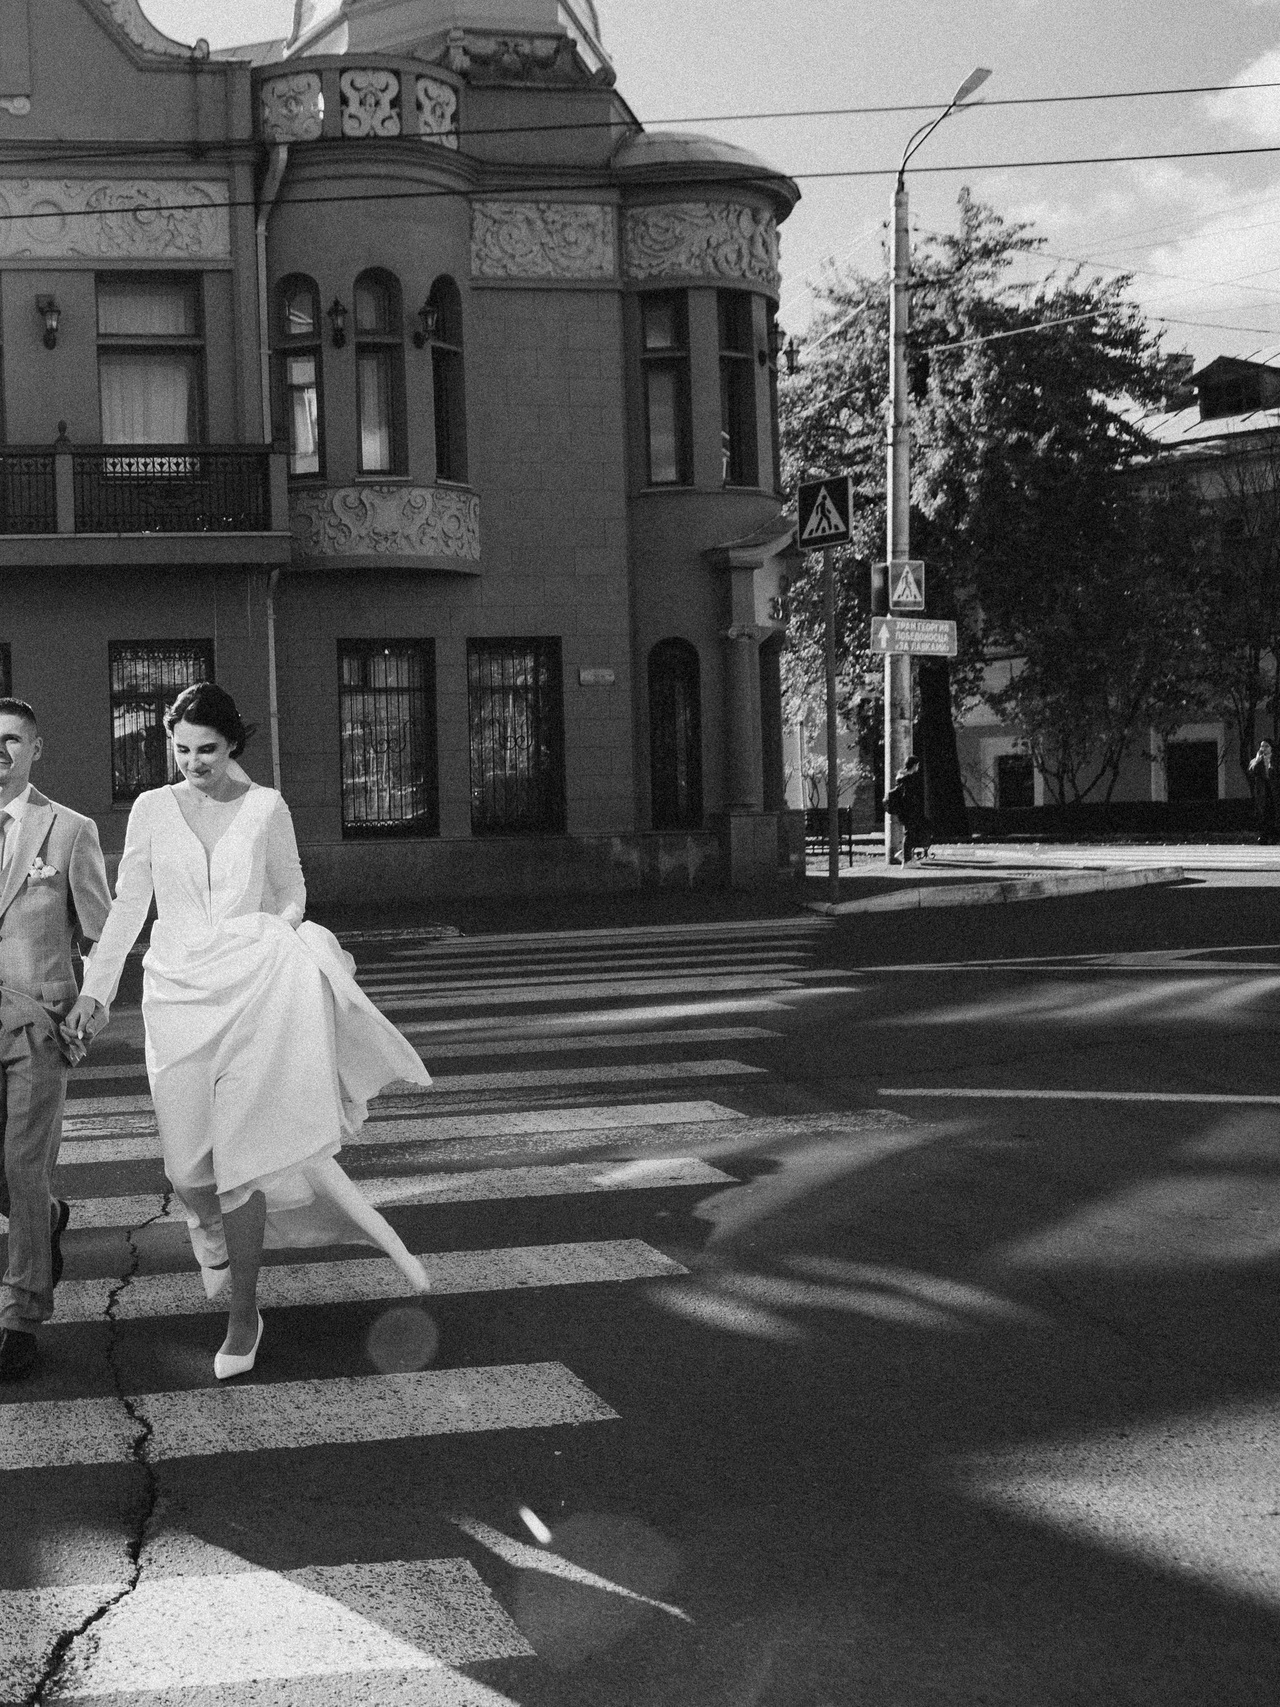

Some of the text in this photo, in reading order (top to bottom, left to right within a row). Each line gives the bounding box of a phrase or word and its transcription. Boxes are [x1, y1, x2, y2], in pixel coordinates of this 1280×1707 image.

[895, 621, 950, 632] ХРАМ ГЕОРГИЯ
[895, 631, 949, 643] ПОБЕДОНОСЦА
